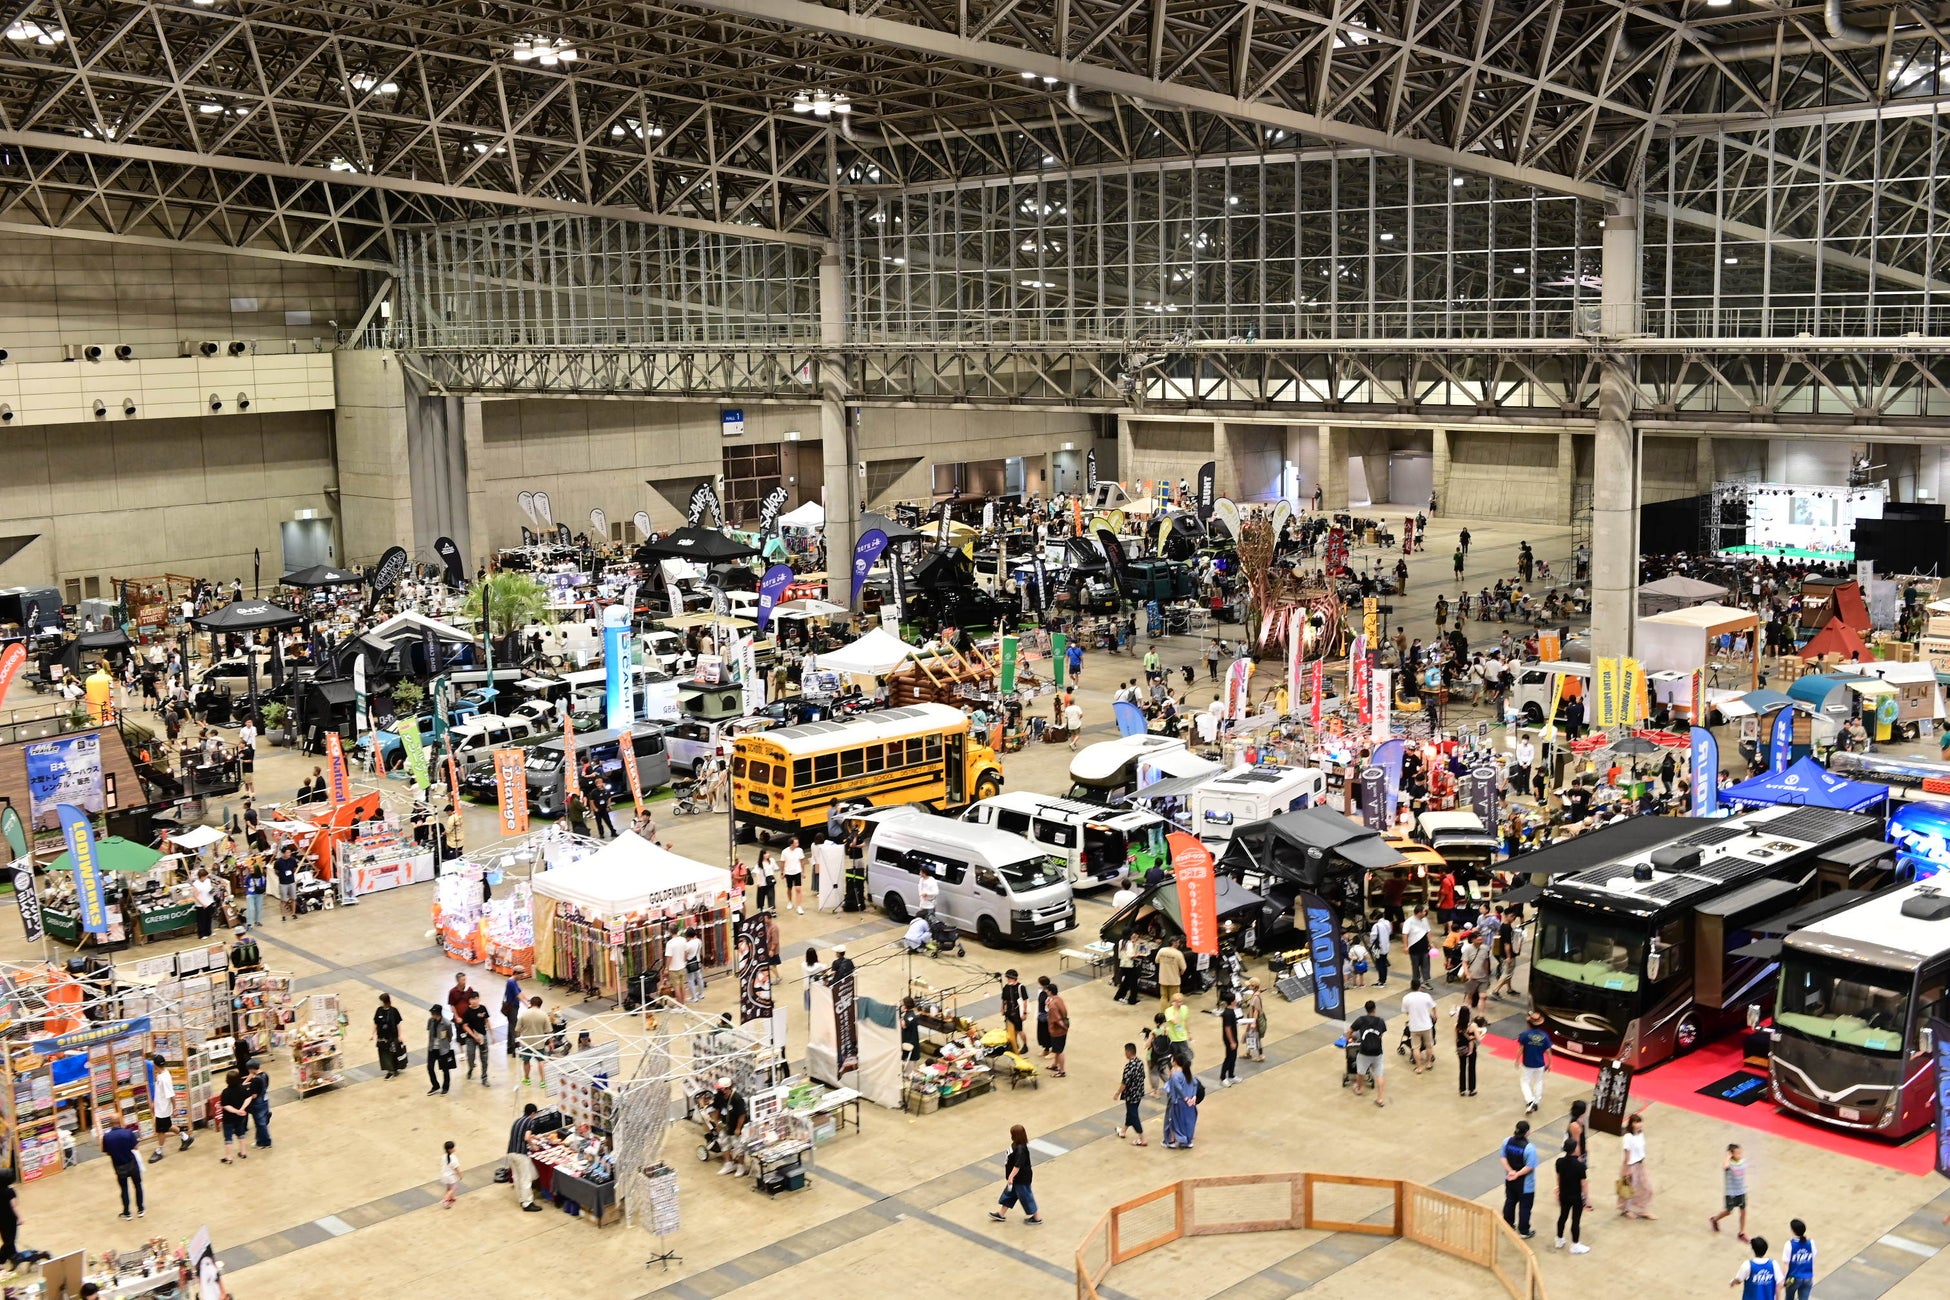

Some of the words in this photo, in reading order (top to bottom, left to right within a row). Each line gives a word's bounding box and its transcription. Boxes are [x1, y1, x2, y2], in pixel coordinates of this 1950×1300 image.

[760, 486, 788, 529] SAHARA
[1624, 670, 1633, 692] ASTRO
[1620, 691, 1630, 722] PRODUCTS
[330, 736, 339, 756] K9
[332, 756, 346, 803] Natural
[801, 789, 813, 797] LOS
[819, 784, 843, 792] ANGELES
[848, 778, 868, 787] UNIFIED
[873, 774, 894, 783] SCHOOL
[900, 768, 922, 777] DISTRICT
[501, 766, 515, 830] Diange
[72, 821, 102, 926] LODIWORKS
[650, 882, 698, 904] GOLDENMAMA
[144, 914, 170, 924] GREEN
[170, 911, 188, 919] DOG
[1792, 1252, 1813, 1262] STAFF
[1752, 1274, 1774, 1283] STAFF
